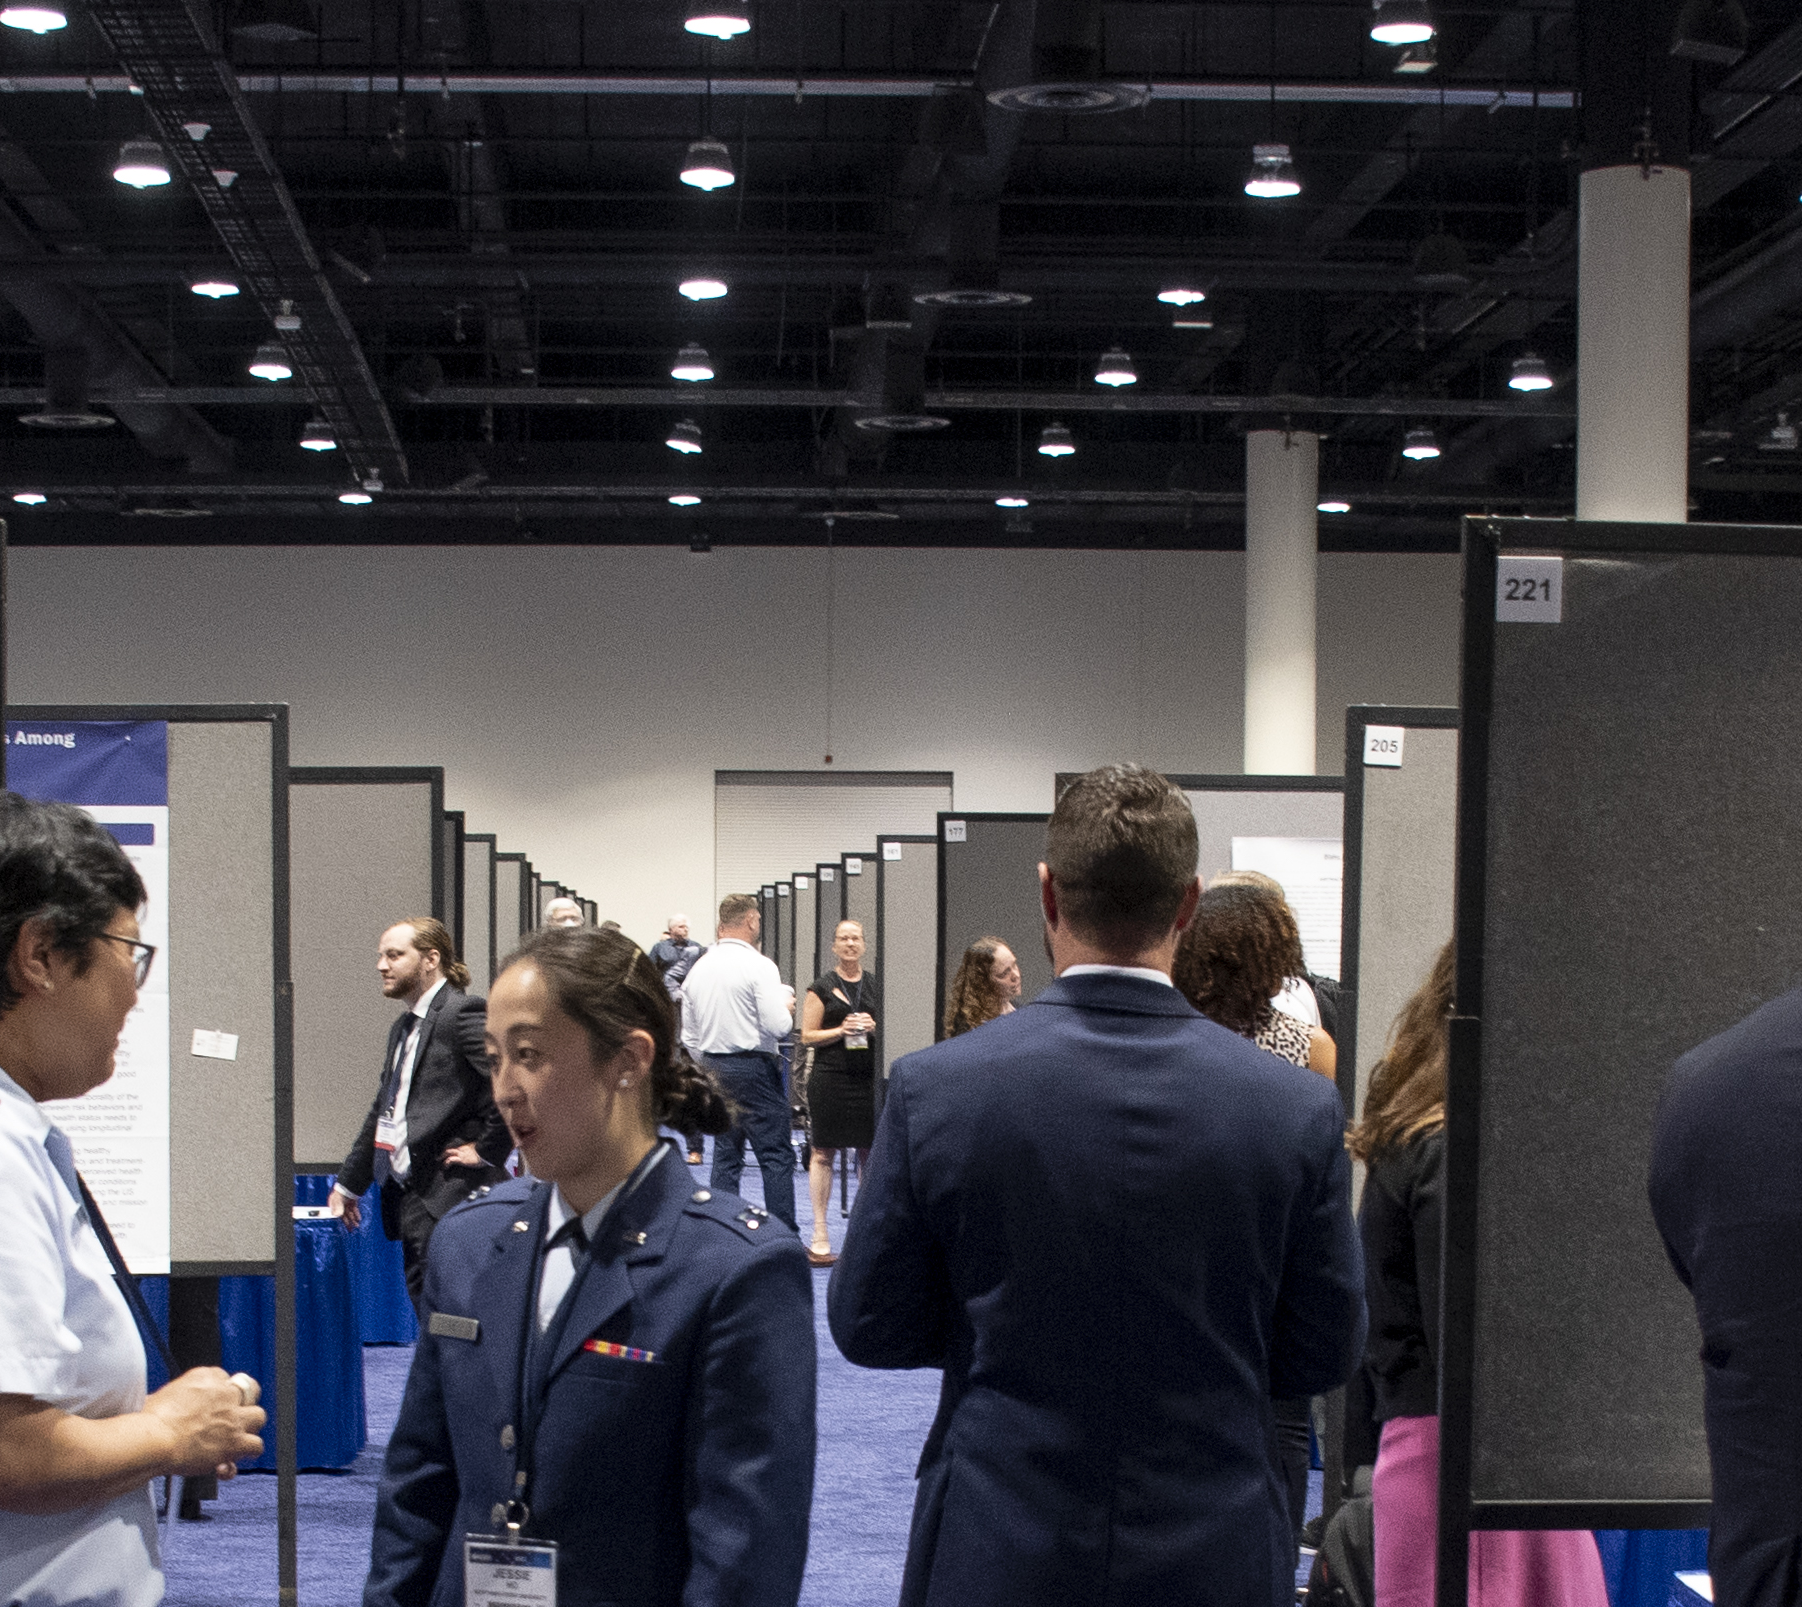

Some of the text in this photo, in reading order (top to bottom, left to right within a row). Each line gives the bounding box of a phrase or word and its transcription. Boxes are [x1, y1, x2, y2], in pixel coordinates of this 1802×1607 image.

[1505, 578, 1550, 601] 221
[14, 730, 76, 748] Among
[1370, 739, 1398, 753] 205
